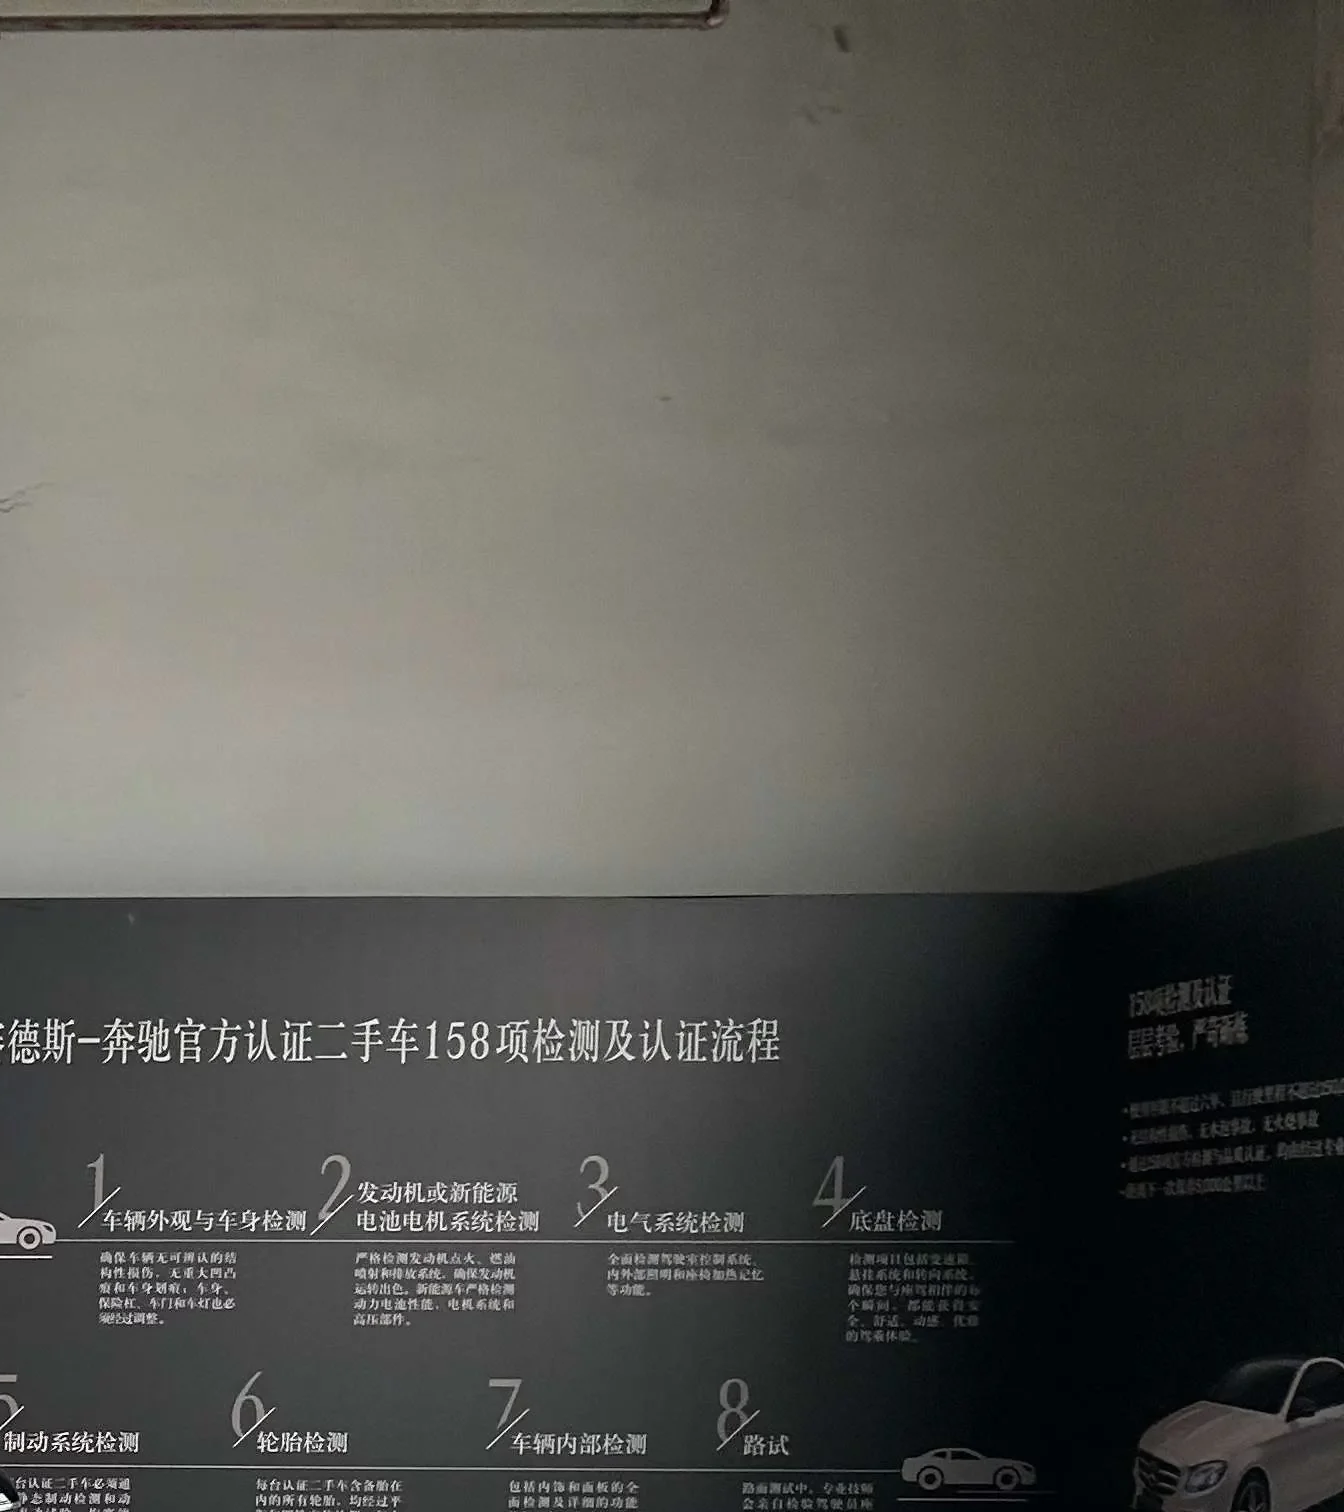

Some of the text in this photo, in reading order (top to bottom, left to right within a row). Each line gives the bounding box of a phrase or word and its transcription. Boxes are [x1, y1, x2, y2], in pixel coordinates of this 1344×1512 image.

[87, 1153, 104, 1210] 1
[318, 1154, 351, 1221] 2
[357, 1180, 519, 1205] 发动机或新能源
[576, 1155, 610, 1218] 3
[812, 1155, 855, 1213] 4
[102, 1209, 307, 1233] 车辆外观与车身检测
[356, 1208, 541, 1234] 电池电机系统检测
[607, 1211, 745, 1234] 电气系统检测
[849, 1209, 944, 1233] 底盘检测
[231, 1371, 266, 1438] 6
[488, 1378, 523, 1430] 7
[4, 1431, 140, 1454] 制动系统检测
[256, 1431, 349, 1454] 轮胎检测
[511, 1432, 648, 1456] 车辆内部检测
[743, 1435, 790, 1456] 路试
